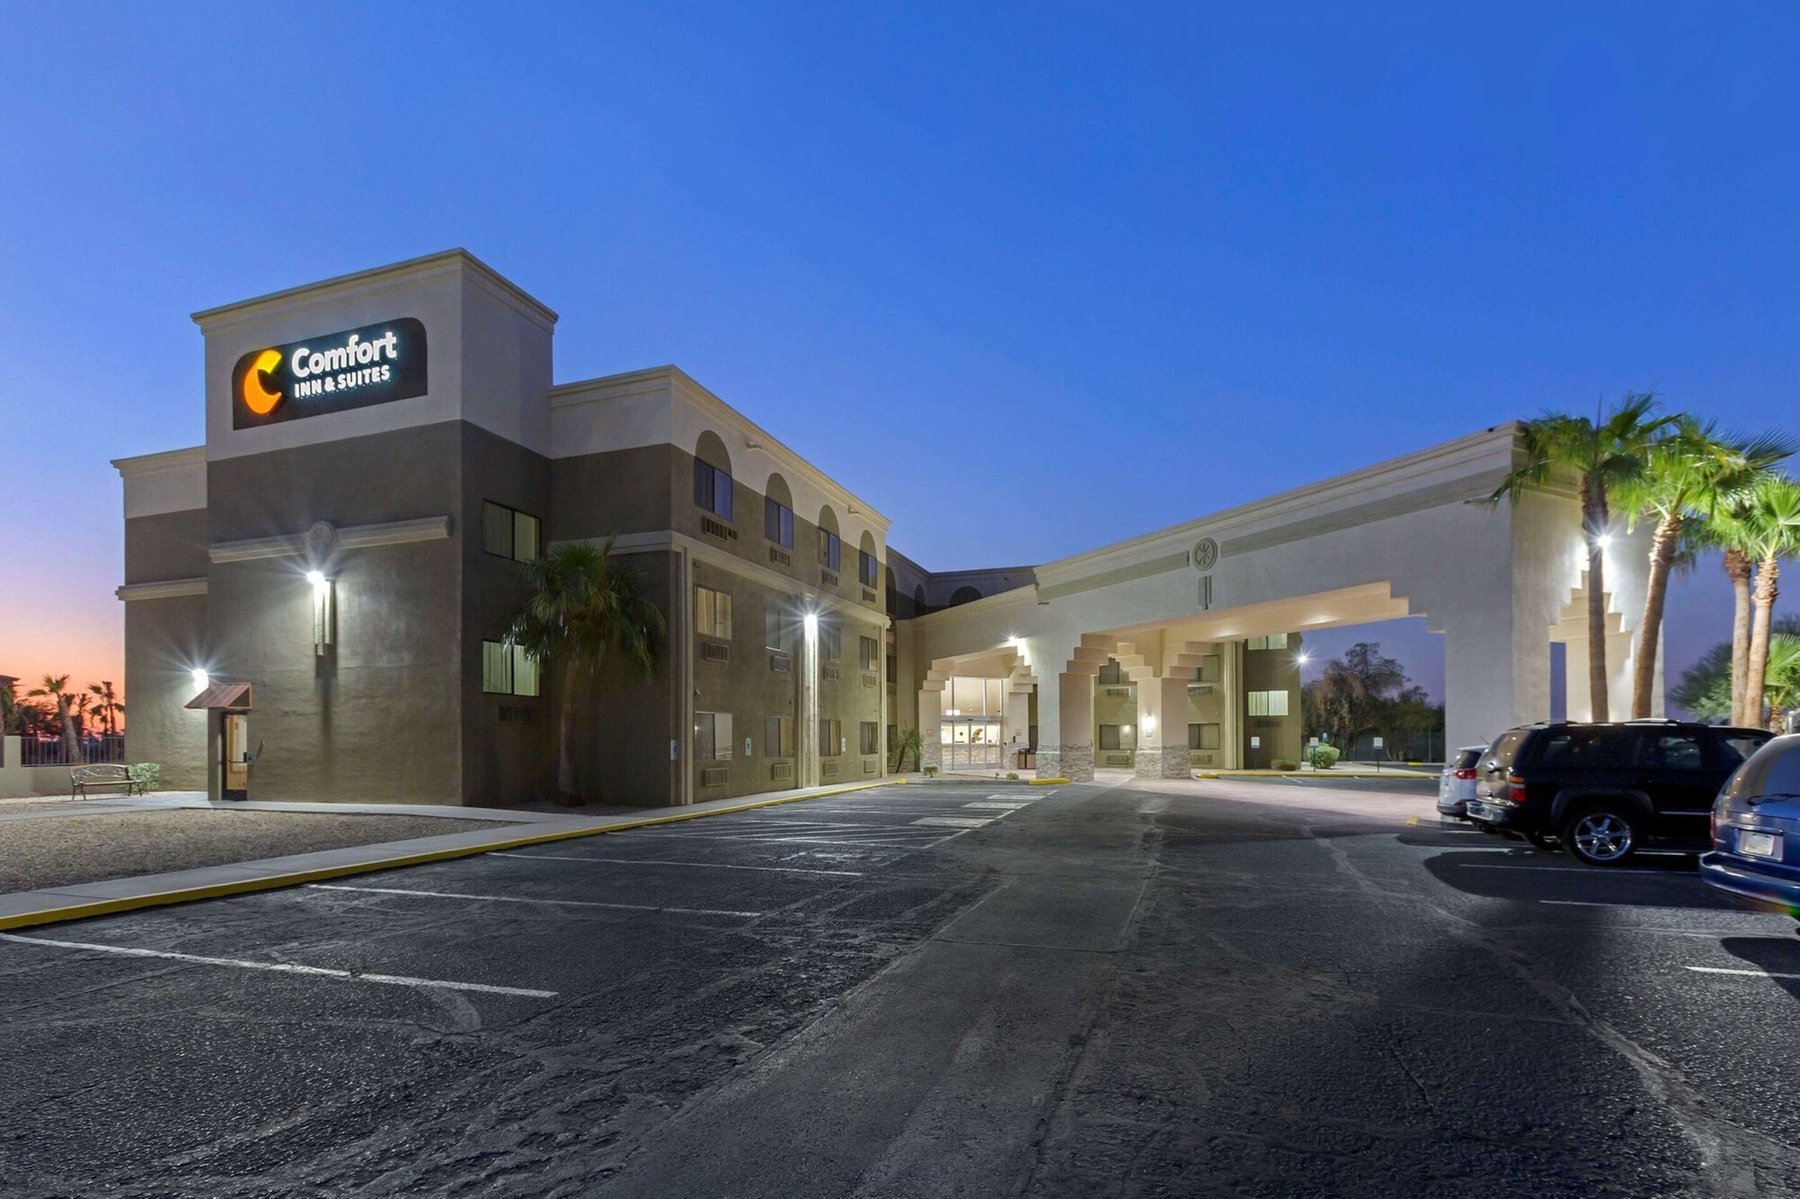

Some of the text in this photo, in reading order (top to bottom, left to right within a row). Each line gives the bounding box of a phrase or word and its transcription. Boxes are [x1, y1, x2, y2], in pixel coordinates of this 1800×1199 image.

[291, 332, 397, 377] Comfort
[295, 365, 390, 398] INN & SUITES
